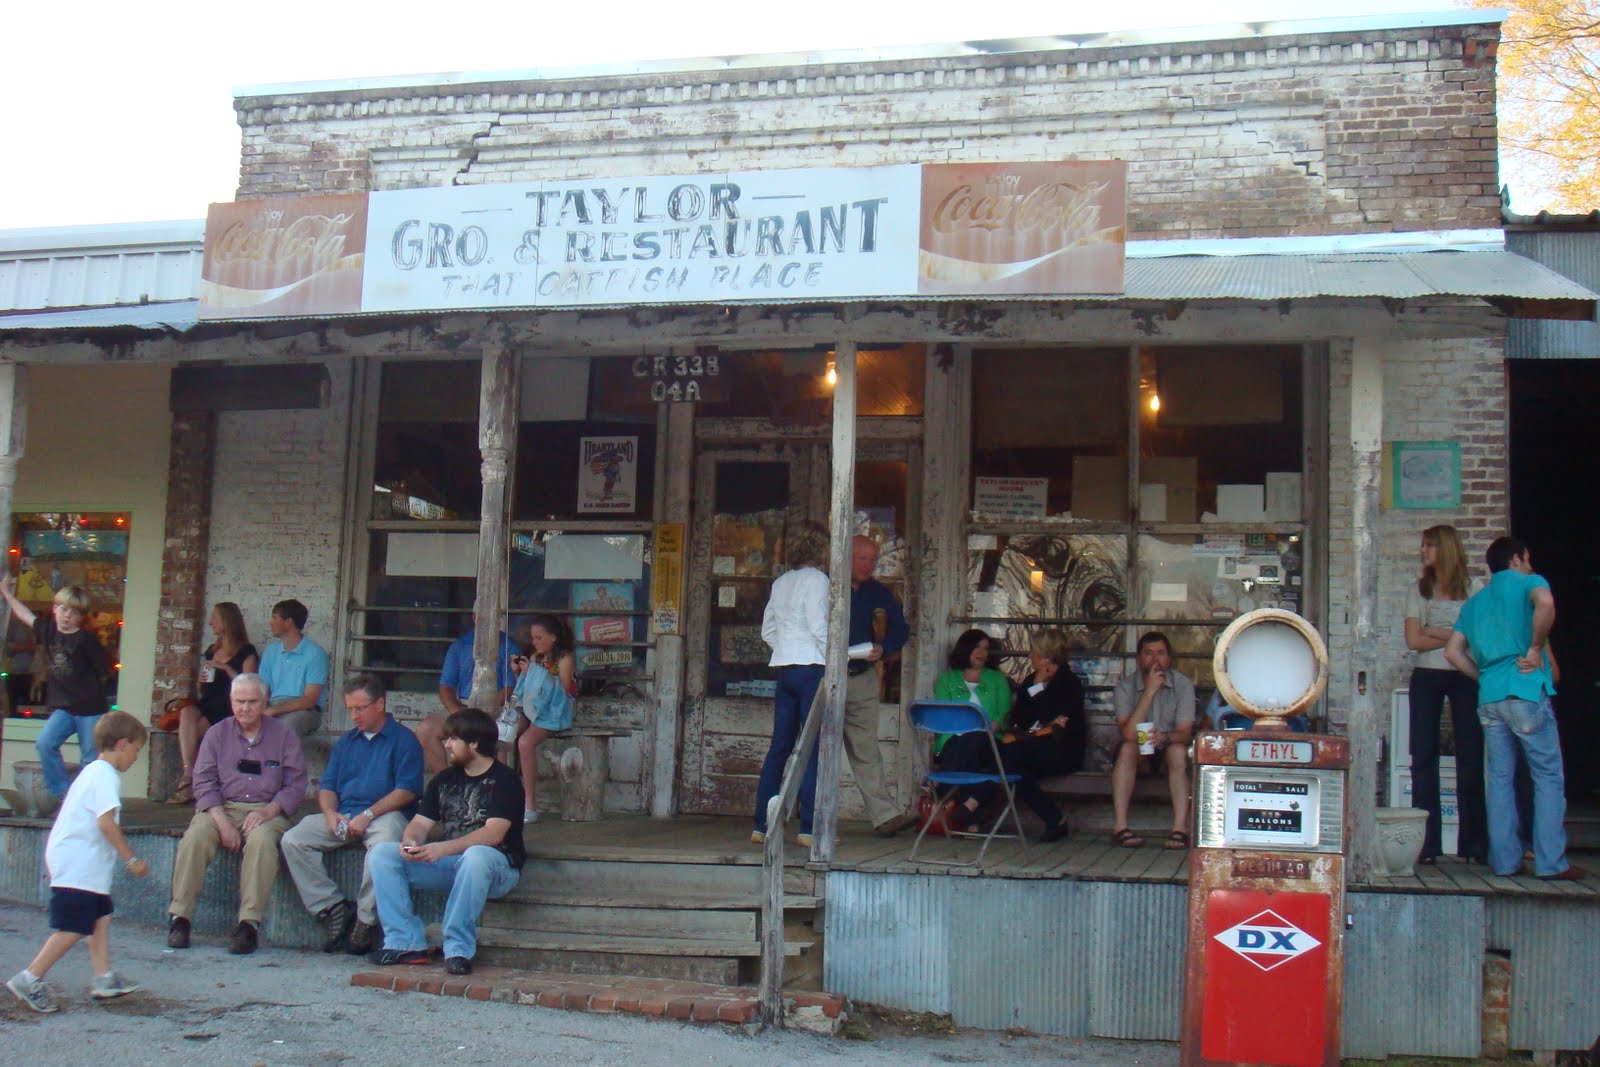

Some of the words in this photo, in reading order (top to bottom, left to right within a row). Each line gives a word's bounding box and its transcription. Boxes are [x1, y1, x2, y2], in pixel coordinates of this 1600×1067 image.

[525, 182, 742, 228] TAYLOR
[513, 229, 543, 265] &
[565, 196, 889, 262] RESTAURANT
[441, 271, 522, 298] THAT
[537, 266, 689, 298] CATFISH
[712, 261, 824, 289] PLACE
[673, 355, 721, 377] 338
[583, 440, 634, 466] HEARTLAND
[1250, 741, 1300, 761] ETHYL
[1248, 817, 1292, 825] GALLONS
[1236, 929, 1300, 951] DX
